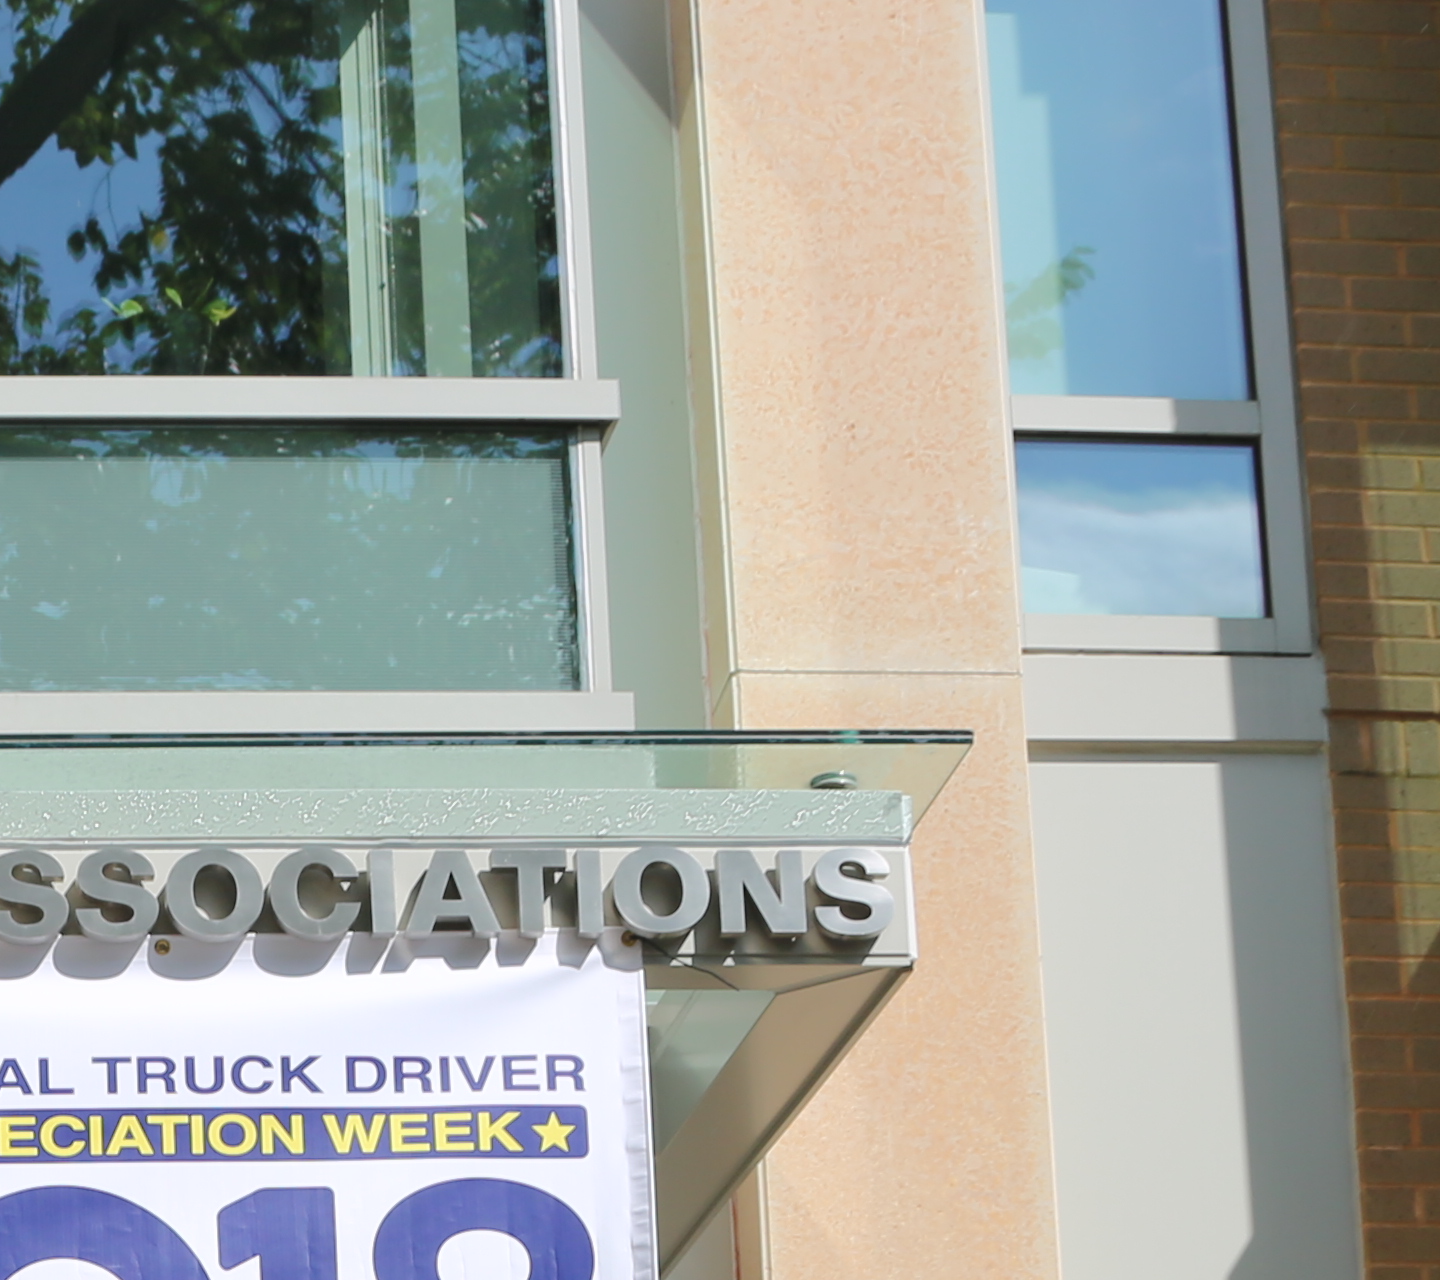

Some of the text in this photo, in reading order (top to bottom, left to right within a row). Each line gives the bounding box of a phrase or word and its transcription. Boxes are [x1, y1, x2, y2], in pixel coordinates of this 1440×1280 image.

[92, 1056, 320, 1095] TRUCK
[345, 1054, 585, 1093] DRIVER
[323, 1112, 523, 1154] WEEK
